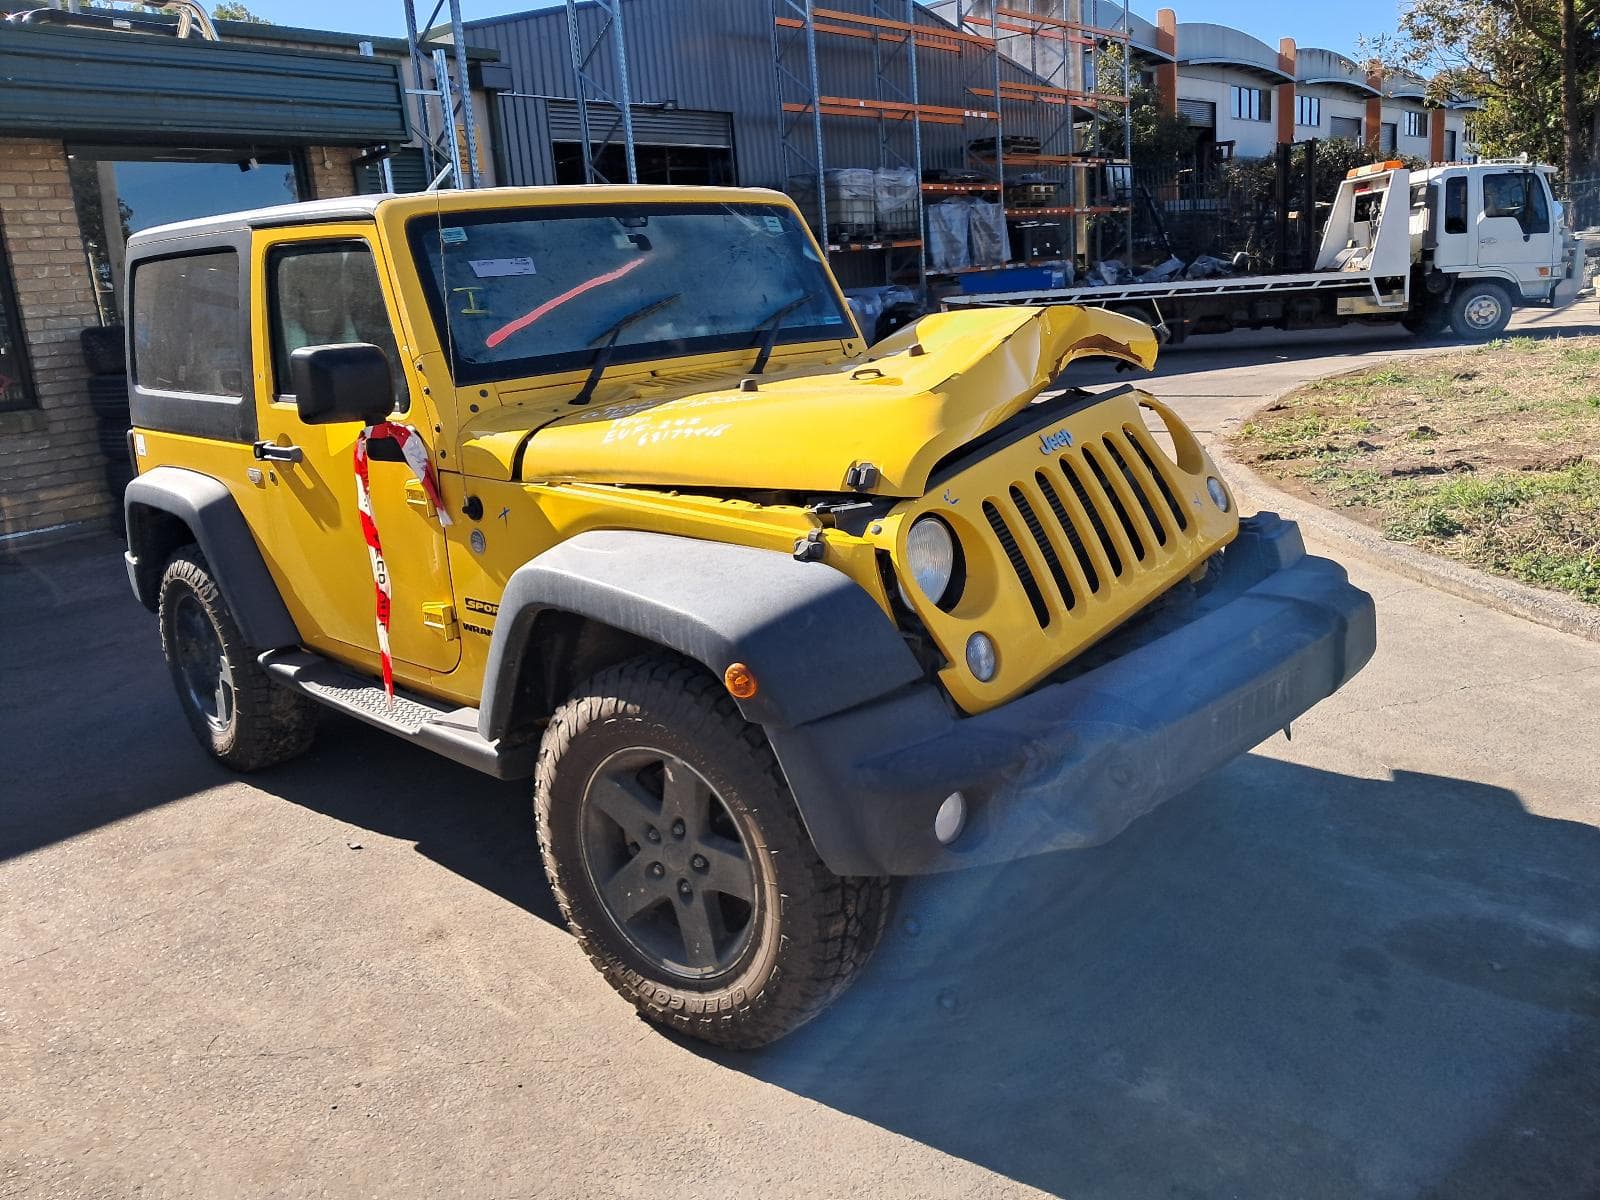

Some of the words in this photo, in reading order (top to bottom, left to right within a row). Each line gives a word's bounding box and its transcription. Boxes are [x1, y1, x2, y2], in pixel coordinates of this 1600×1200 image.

[1038, 430, 1073, 455] Jeep
[466, 599, 499, 614] SPOR
[462, 621, 494, 637] WRAN
[686, 985, 745, 1013] OPEN
